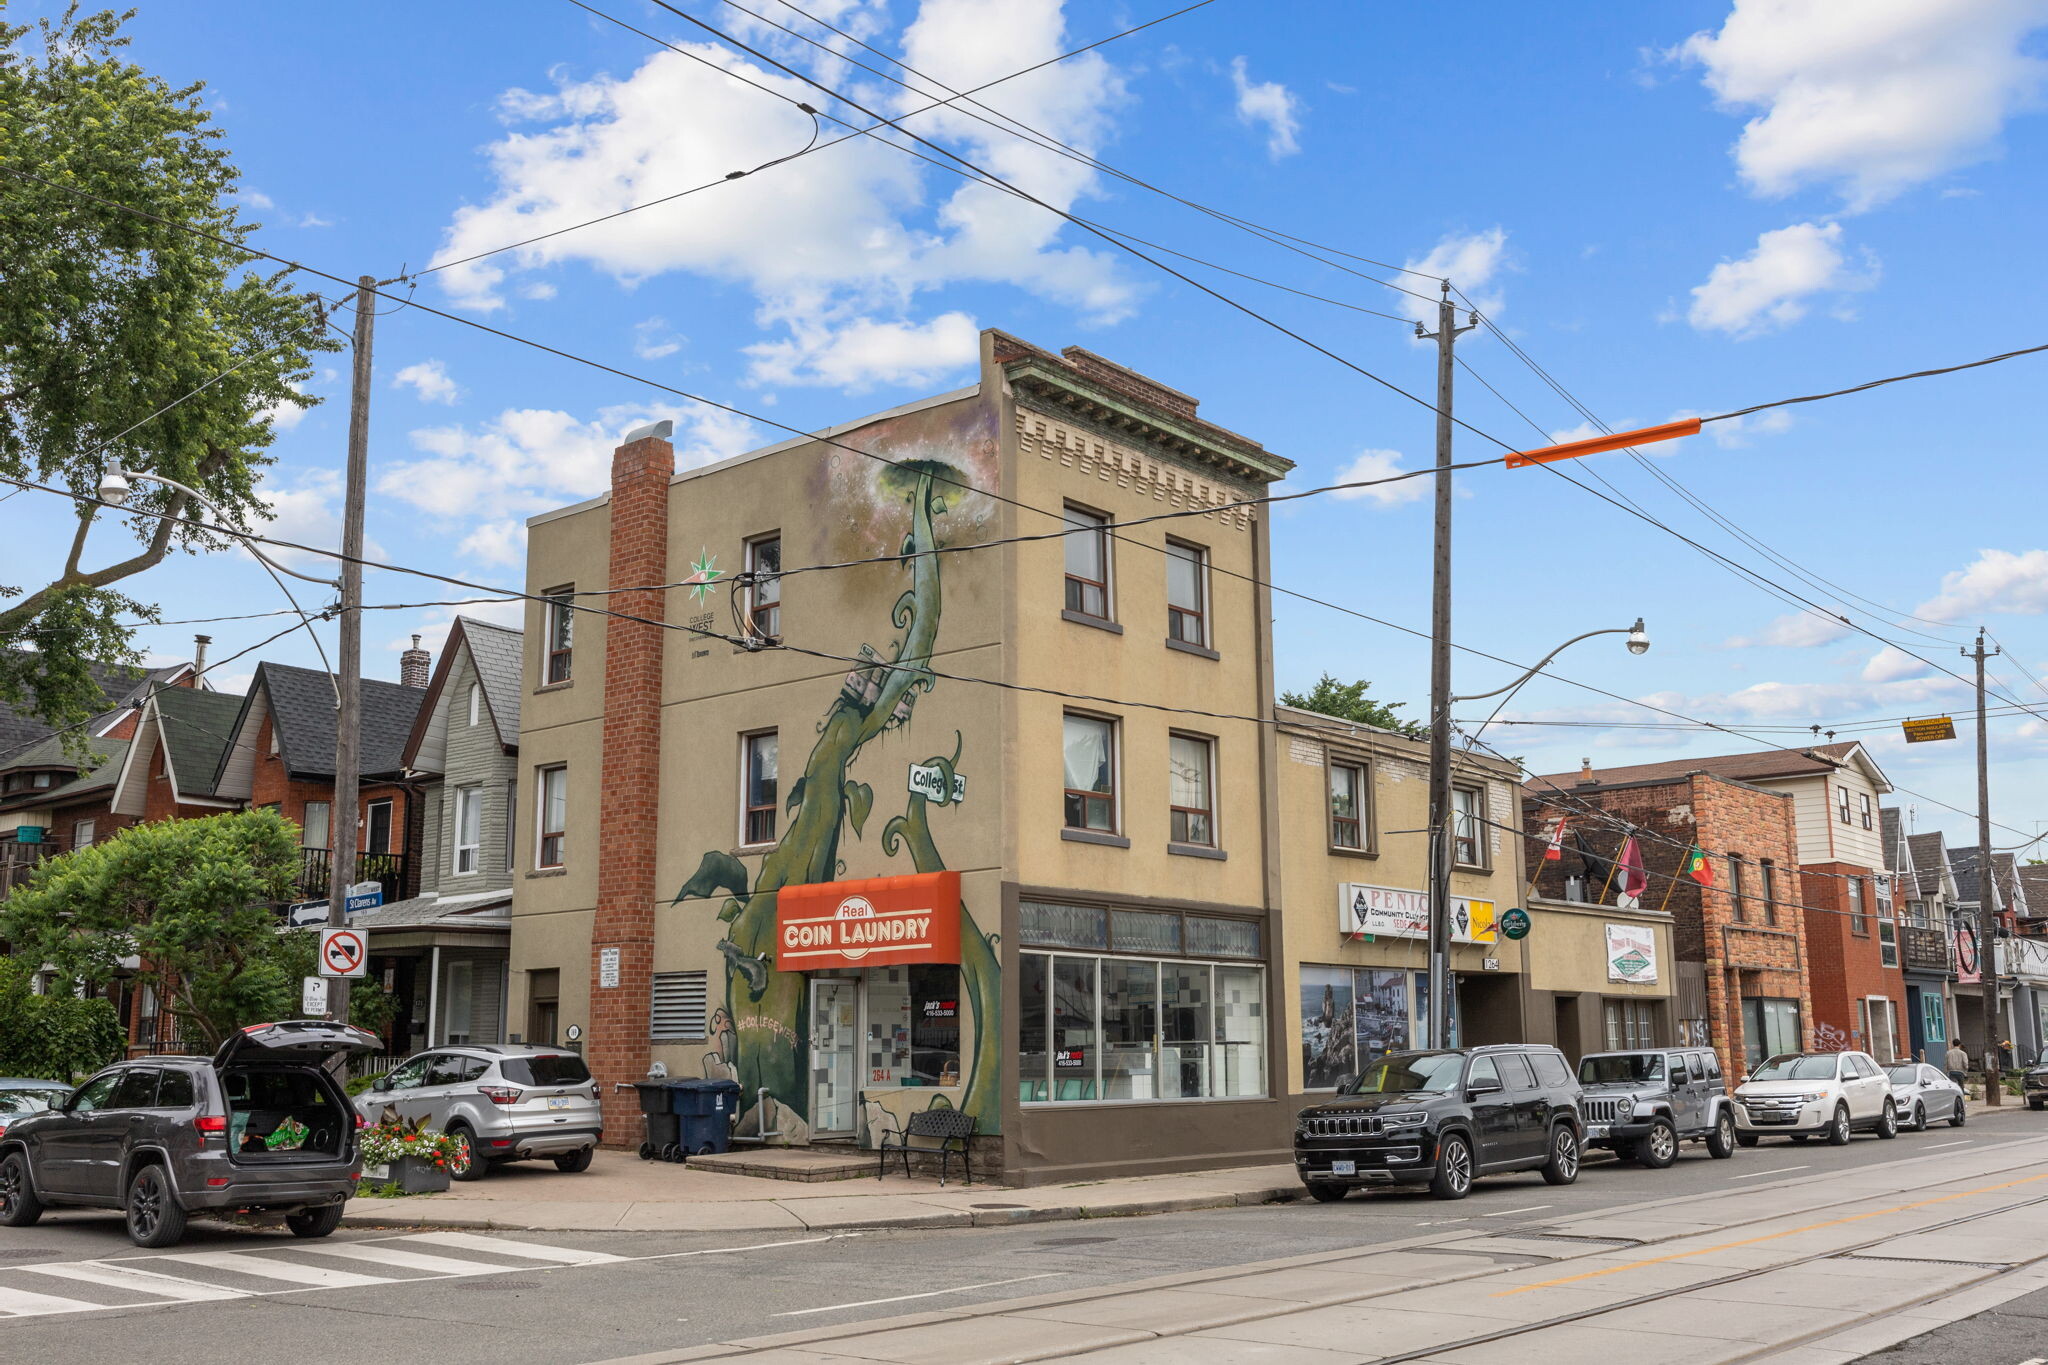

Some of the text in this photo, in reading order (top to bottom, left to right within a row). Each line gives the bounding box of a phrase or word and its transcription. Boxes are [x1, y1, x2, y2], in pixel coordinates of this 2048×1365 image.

[690, 612, 714, 623] COLLEGE
[690, 620, 714, 634] WEST
[349, 899, 355, 909] St
[355, 898, 370, 908] Clarens
[842, 904, 868, 918] Real
[1371, 908, 1404, 919] COMMUNITY
[1503, 919, 1527, 929] Carlsberg
[784, 917, 930, 948] COIN LAUNDRY
[1485, 959, 1499, 969] 1264
[872, 1069, 891, 1081] 264 A
